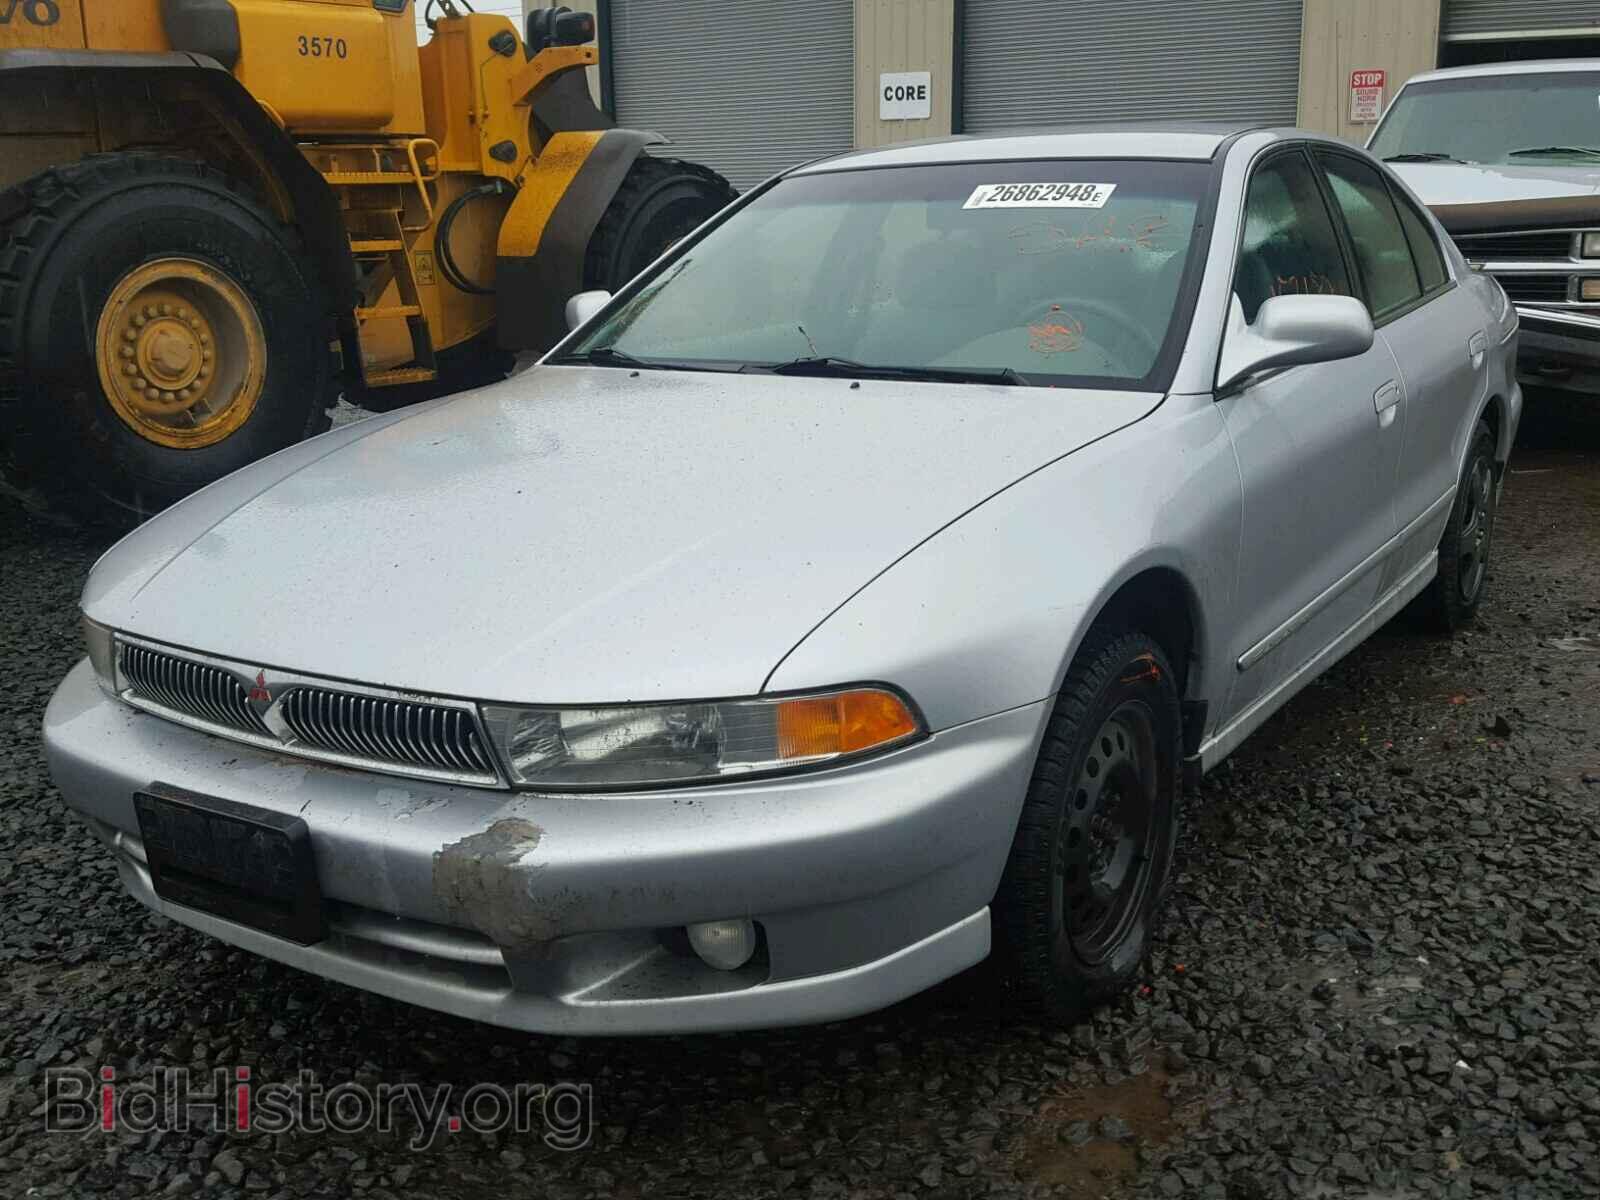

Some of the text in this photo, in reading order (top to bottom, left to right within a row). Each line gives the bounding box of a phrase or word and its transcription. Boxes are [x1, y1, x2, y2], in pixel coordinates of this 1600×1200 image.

[298, 35, 347, 59] 3570
[1353, 73, 1382, 86] STOP
[884, 85, 926, 101] CORE
